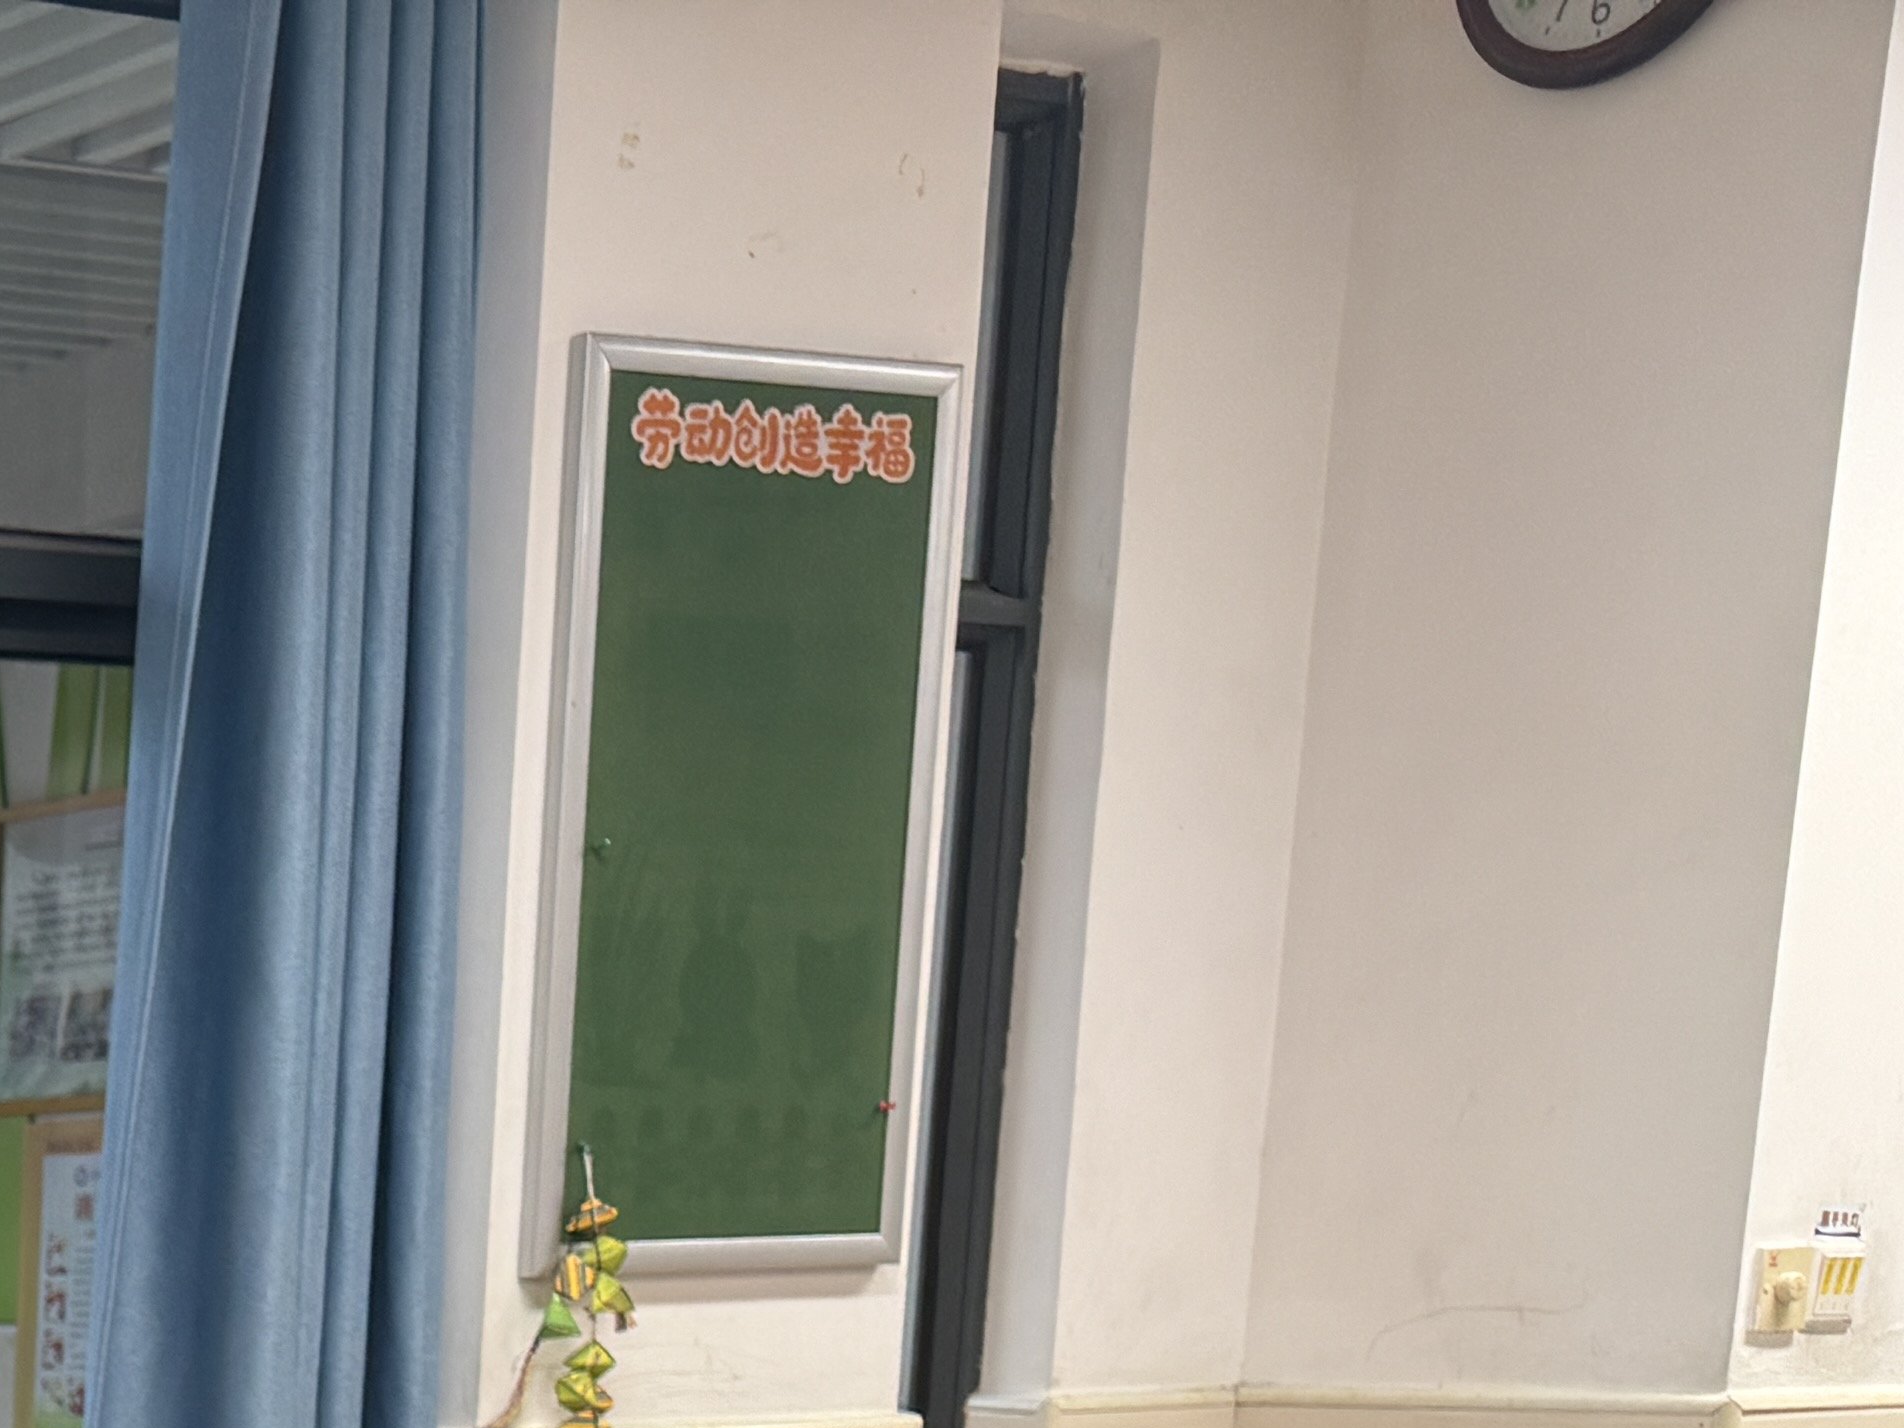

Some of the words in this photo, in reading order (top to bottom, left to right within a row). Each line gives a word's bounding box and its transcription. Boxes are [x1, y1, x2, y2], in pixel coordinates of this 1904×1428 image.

[631, 387, 915, 483] 劳动创造幸福
